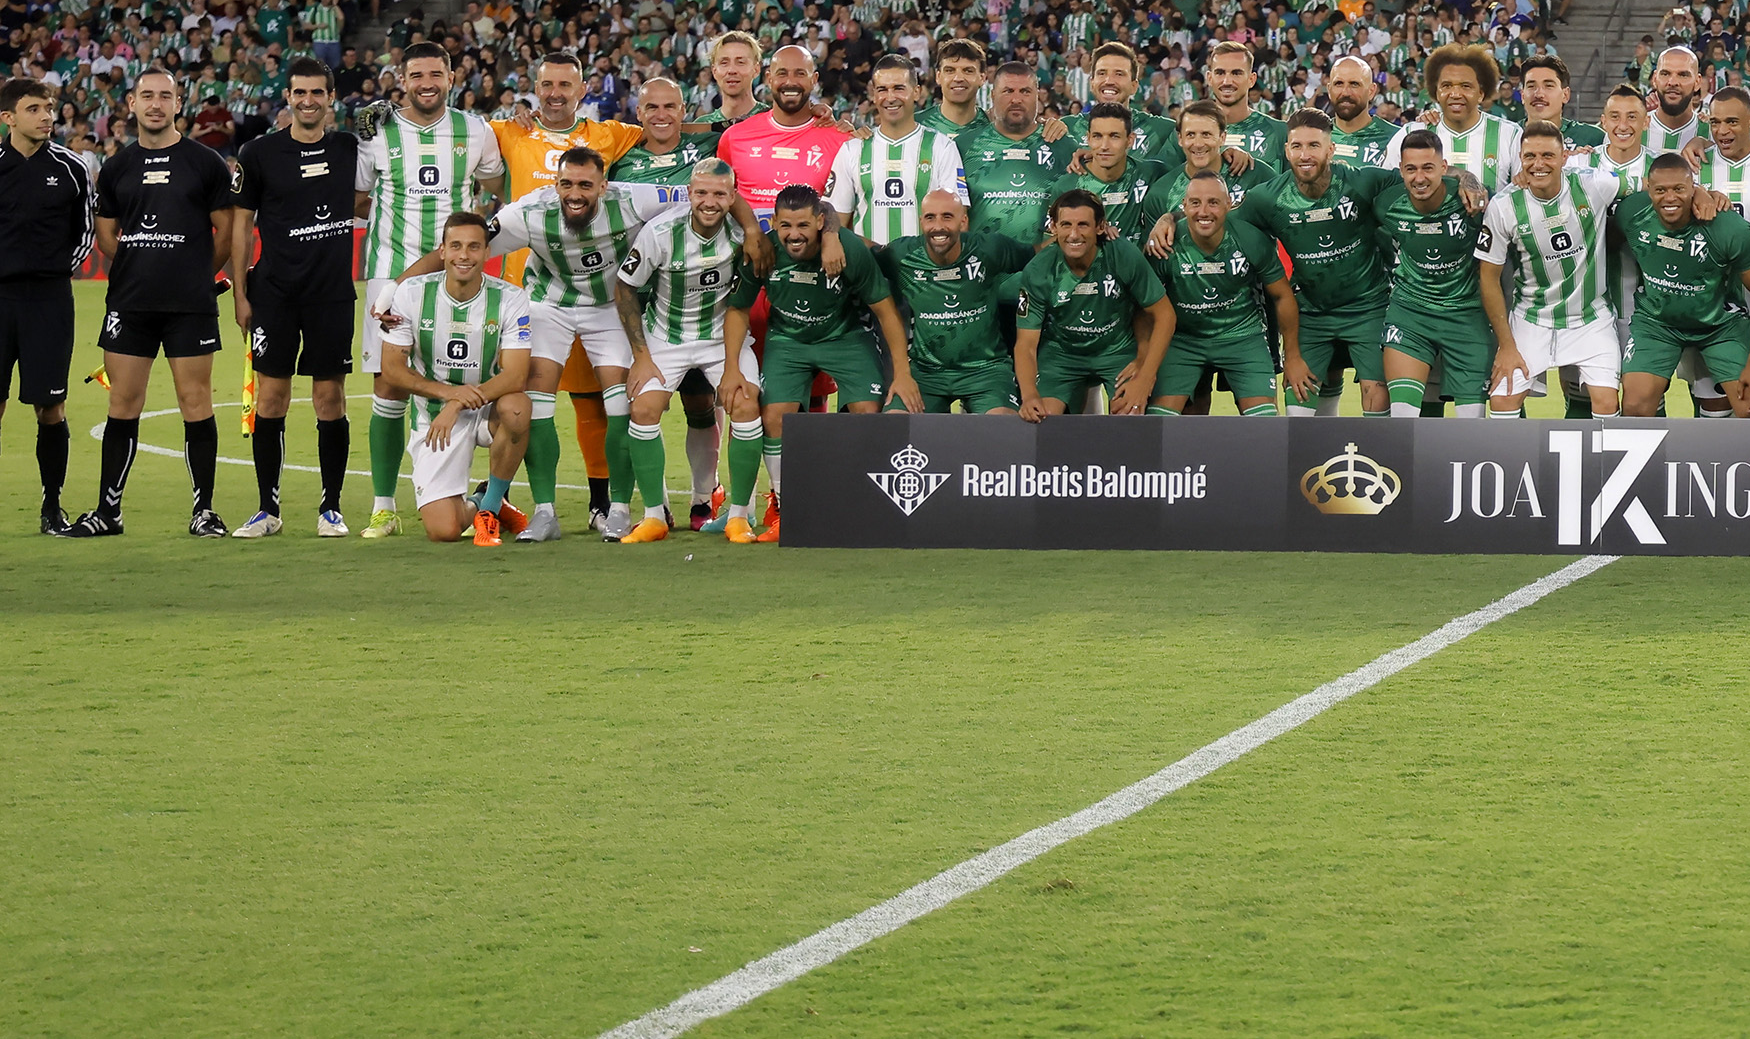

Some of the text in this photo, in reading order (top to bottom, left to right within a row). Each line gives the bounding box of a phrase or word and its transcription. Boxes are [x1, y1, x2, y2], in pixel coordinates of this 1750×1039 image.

[875, 199, 915, 207] finetwork
[962, 464, 1207, 505] Real Betis Balompié
